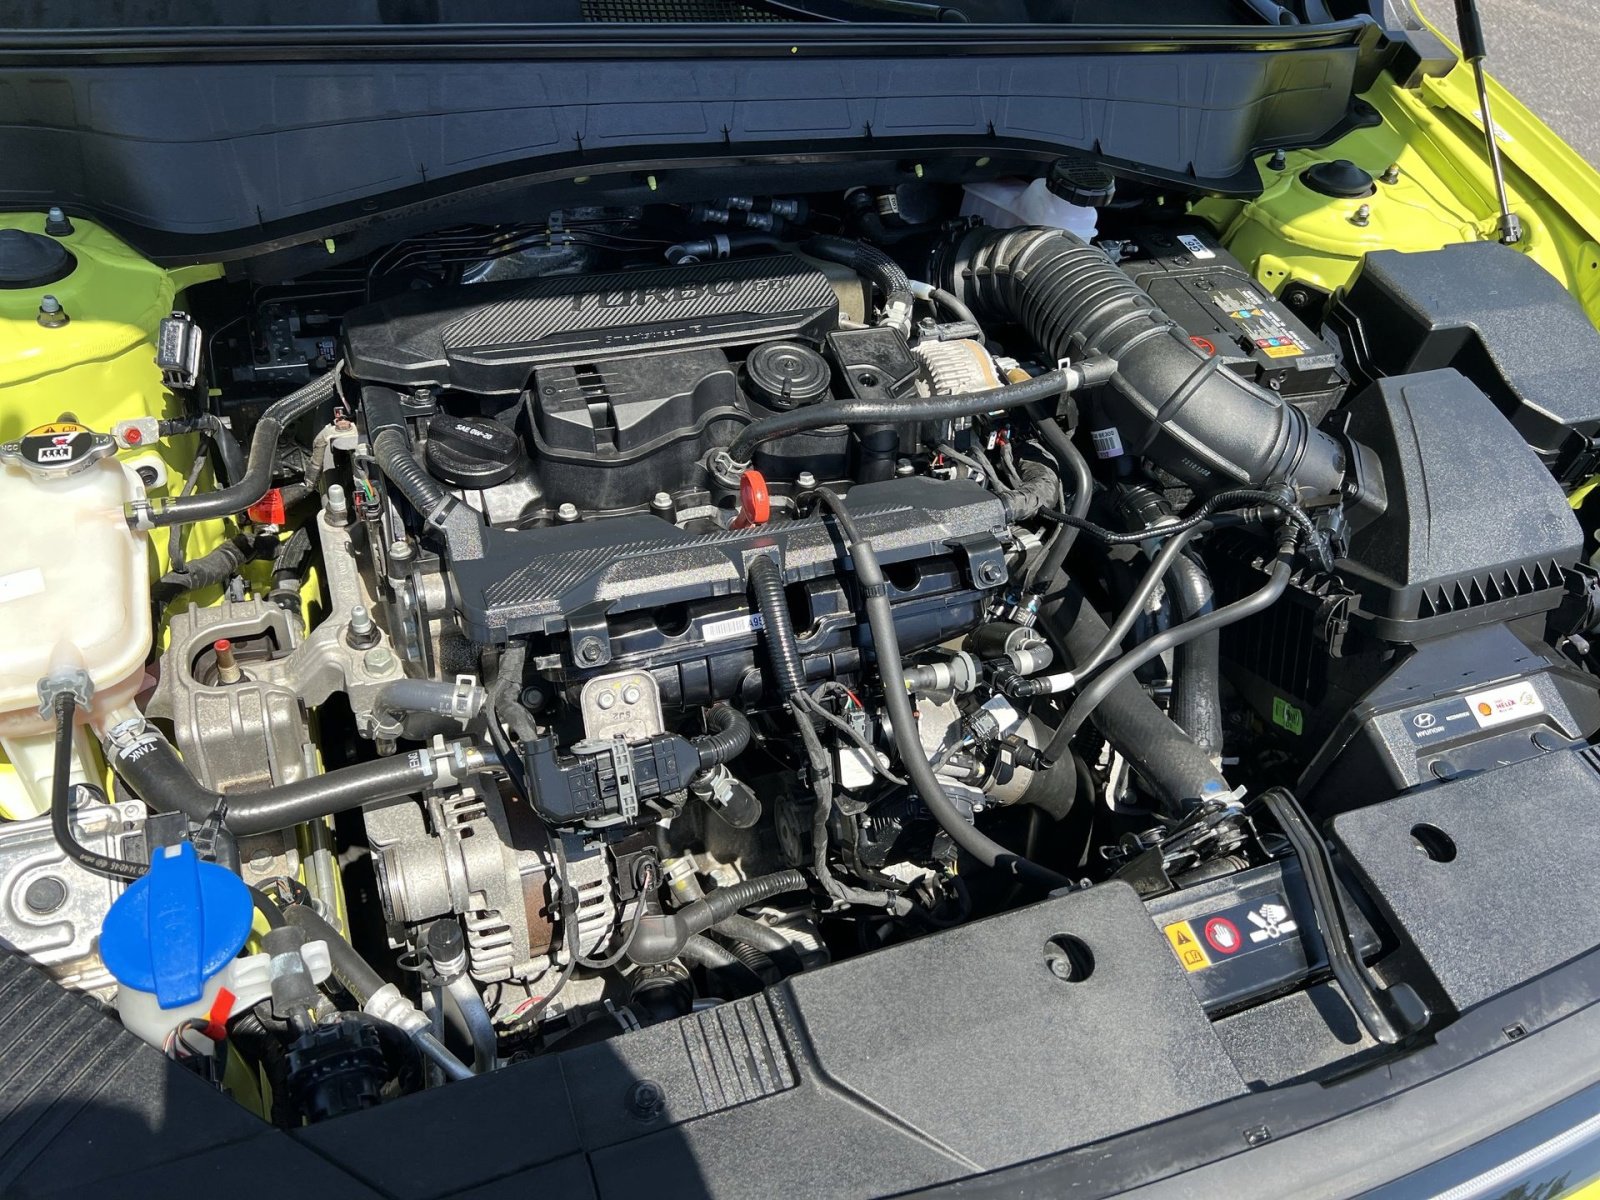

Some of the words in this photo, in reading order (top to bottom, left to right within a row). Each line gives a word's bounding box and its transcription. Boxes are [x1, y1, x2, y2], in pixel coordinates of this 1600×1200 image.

[560, 277, 742, 312] TURBO
[455, 424, 471, 433] SAE
[470, 429, 493, 440] 0W-20
[1416, 726, 1445, 737] HYUNDAI
[128, 743, 158, 762] TANK
[407, 752, 420, 769] ENG
